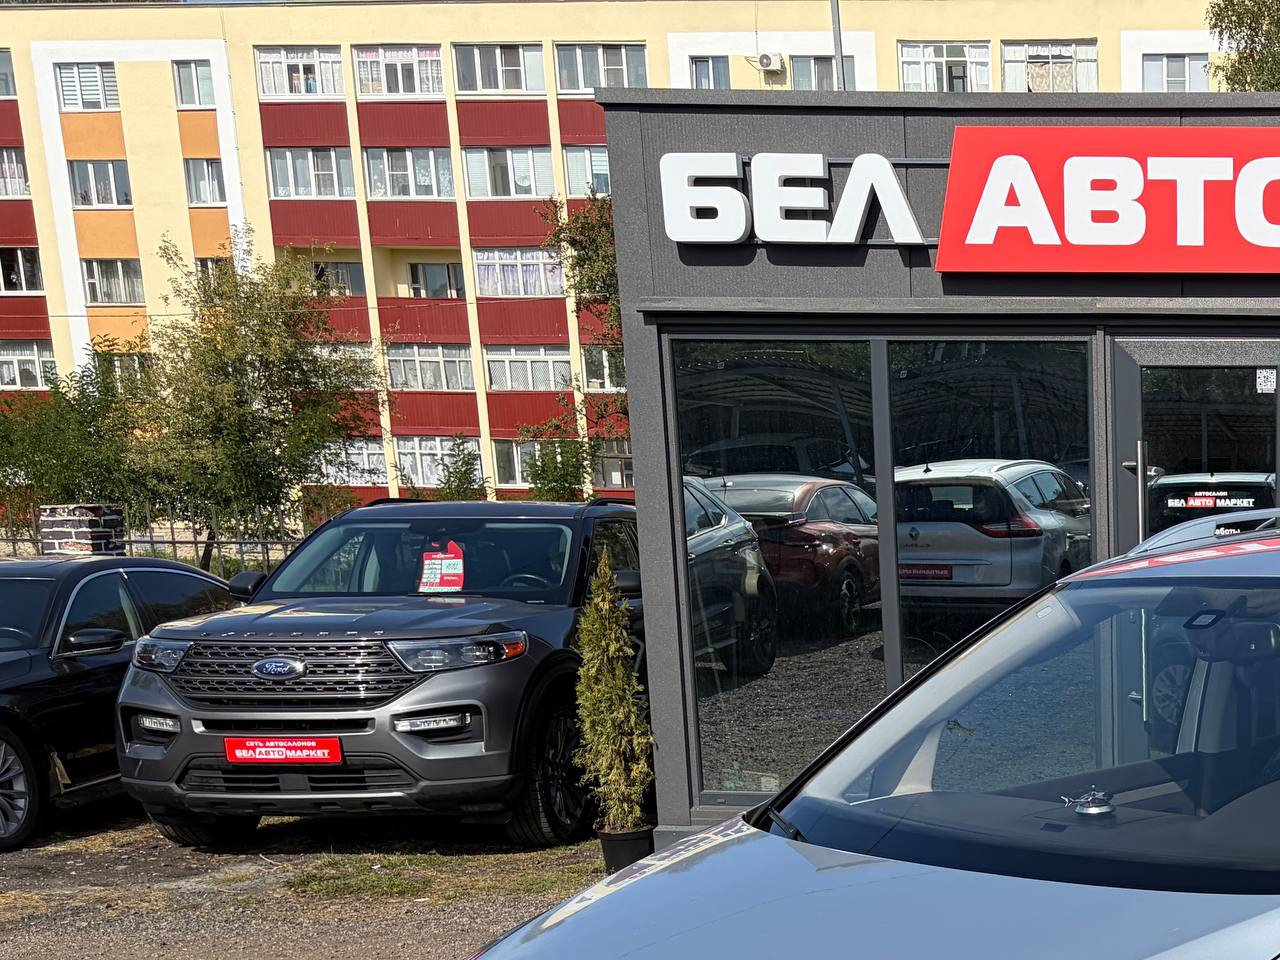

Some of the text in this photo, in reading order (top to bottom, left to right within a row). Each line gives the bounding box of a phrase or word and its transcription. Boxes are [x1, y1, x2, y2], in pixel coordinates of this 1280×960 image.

[659, 152, 926, 244] БЕЛ
[1167, 499, 1255, 507] БЕЛ АВТО МАРКЕТ
[263, 662, 290, 675] Ford
[235, 749, 330, 758] БЕЛ АВТО МАРКЕТ
